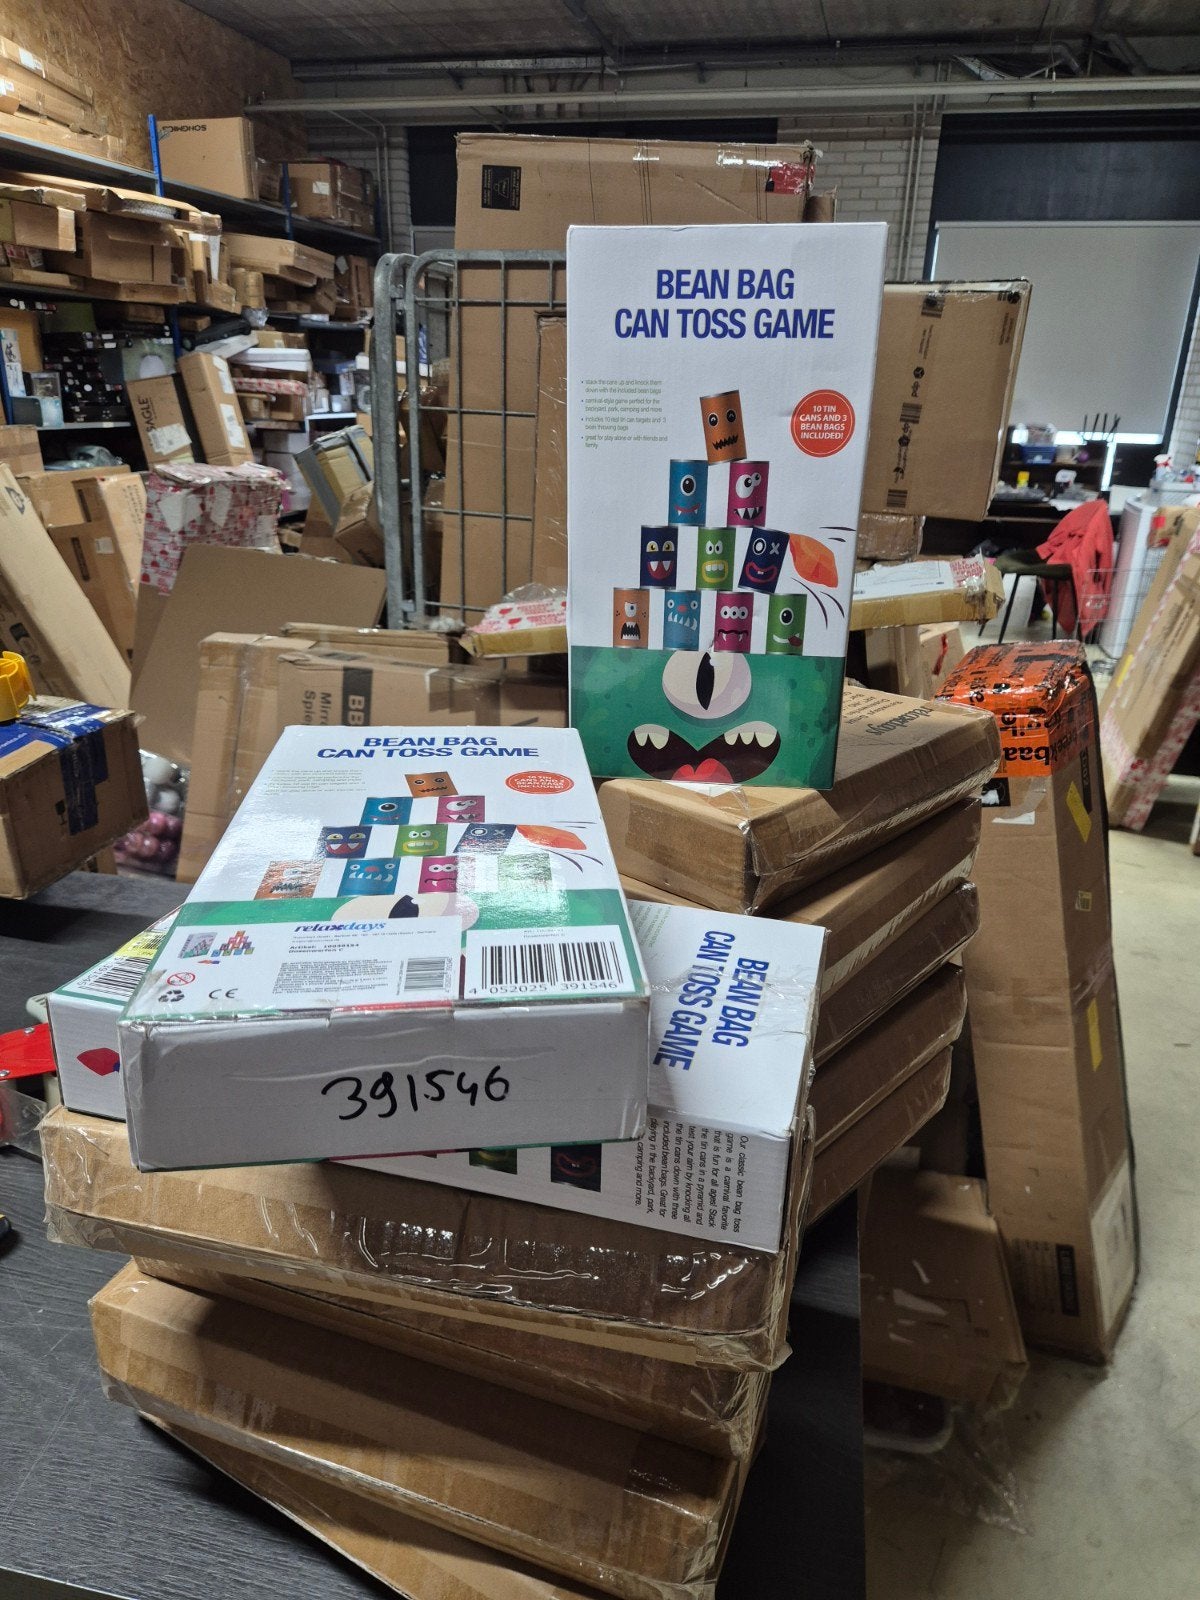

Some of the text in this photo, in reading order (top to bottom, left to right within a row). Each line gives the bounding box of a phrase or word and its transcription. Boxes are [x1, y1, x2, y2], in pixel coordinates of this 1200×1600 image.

[656, 268, 794, 300] BEAN BAG
[614, 308, 835, 339] CAN TOSS GAME
[363, 737, 498, 746] BEAN BAG
[317, 748, 540, 758] CAN TOSS GAME
[294, 922, 386, 932] relaxdays
[490, 984, 547, 994] 052025
[560, 982, 618, 991] 391546
[652, 930, 736, 1070] CAN TOSS GAME
[712, 958, 770, 1047] BEAN BAG
[321, 1064, 511, 1121] 391546
[662, 1120, 670, 1150] included
[676, 1123, 684, 1134] the
[701, 1128, 709, 1139] the
[686, 1140, 694, 1156] your
[725, 1133, 734, 1153] game
[635, 1142, 643, 1171] camping
[649, 1153, 657, 1163] the
[673, 1166, 681, 1185] down
[685, 1171, 692, 1182] by
[712, 1168, 720, 1177] for
[711, 1179, 719, 1187] all
[733, 1135, 749, 1233] Our classic bean bag toss
[660, 1190, 668, 1208] Great
[672, 1187, 680, 1200] with
[682, 1182, 693, 1213] knocking
[696, 1184, 705, 1211] pyramid
[709, 1208, 717, 1228] Stack
[721, 1205, 730, 1231] favorite
